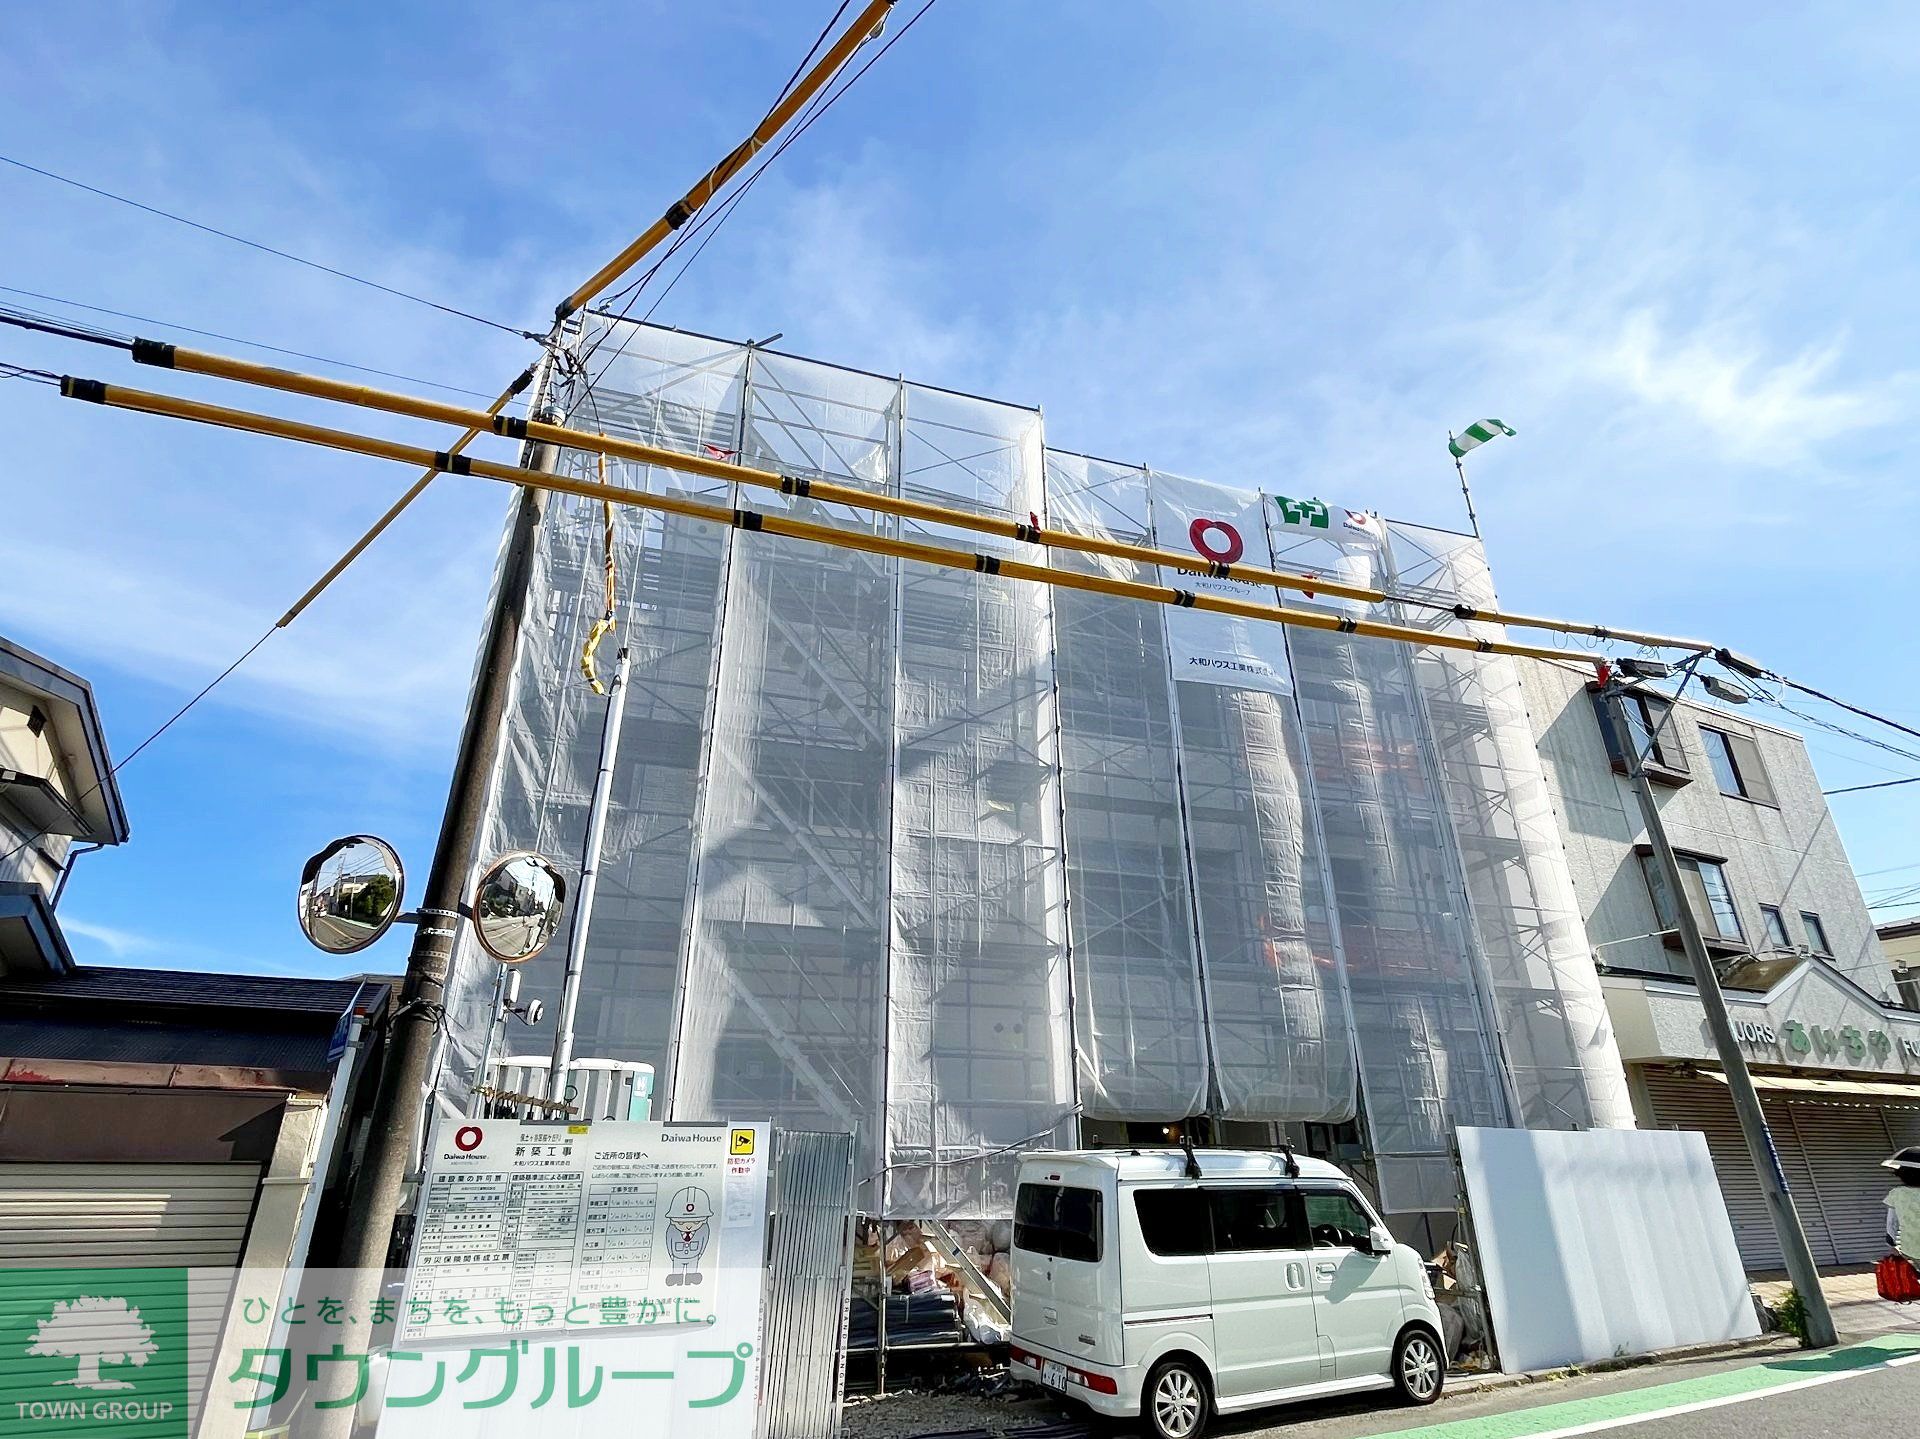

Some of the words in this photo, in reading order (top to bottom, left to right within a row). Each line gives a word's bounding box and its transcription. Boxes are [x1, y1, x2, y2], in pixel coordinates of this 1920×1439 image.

[661, 1133, 692, 1143] Daiwa
[693, 1133, 722, 1143] House
[514, 1146, 573, 1157] 新築工事
[594, 1151, 649, 1160] ご近所の皆様へ
[443, 1153, 466, 1161] Daiwa
[842, 1297, 850, 1340] GRAND
